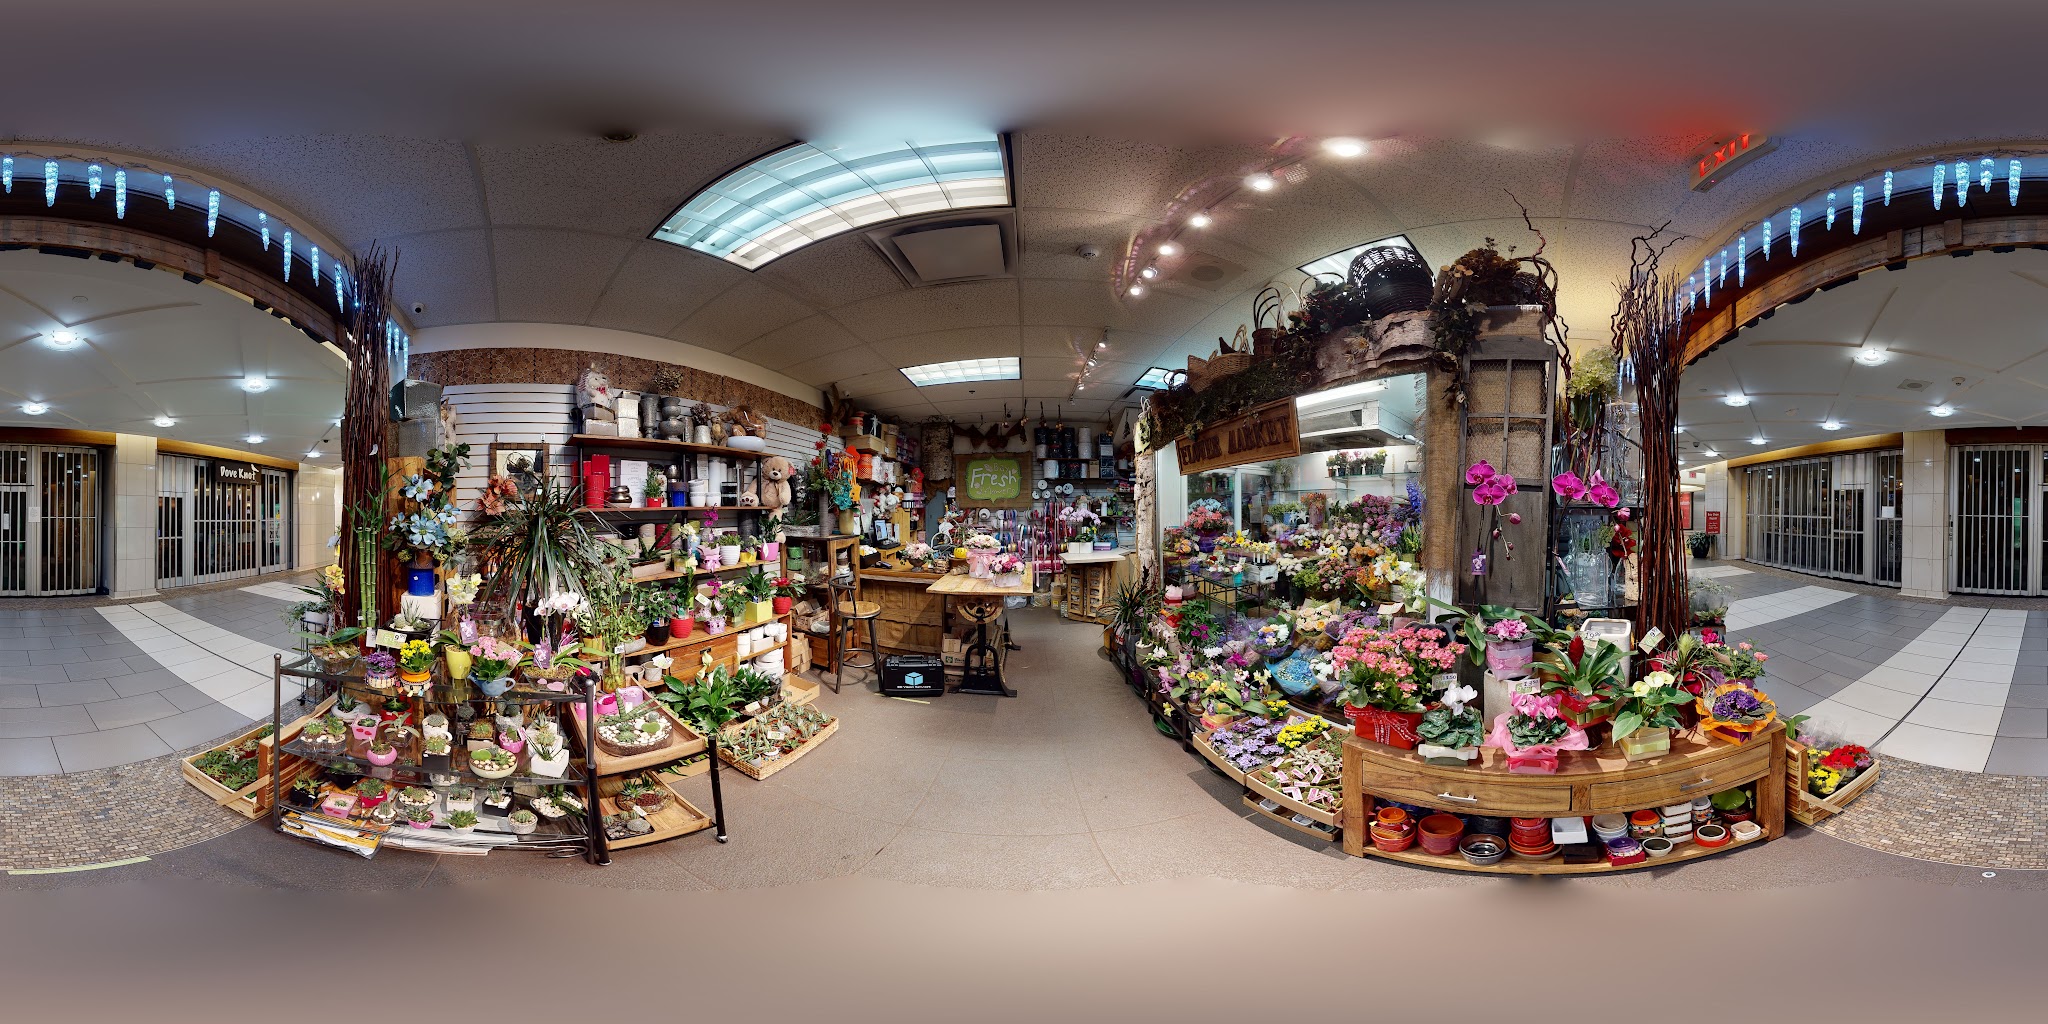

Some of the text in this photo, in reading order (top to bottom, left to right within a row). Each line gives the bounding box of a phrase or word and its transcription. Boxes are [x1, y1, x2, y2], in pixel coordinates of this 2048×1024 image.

[1698, 134, 1750, 178] EXIT
[1179, 415, 1290, 466] FLOWER MARKET
[220, 466, 256, 481] Dove Knot
[970, 467, 1017, 488] Fresh
